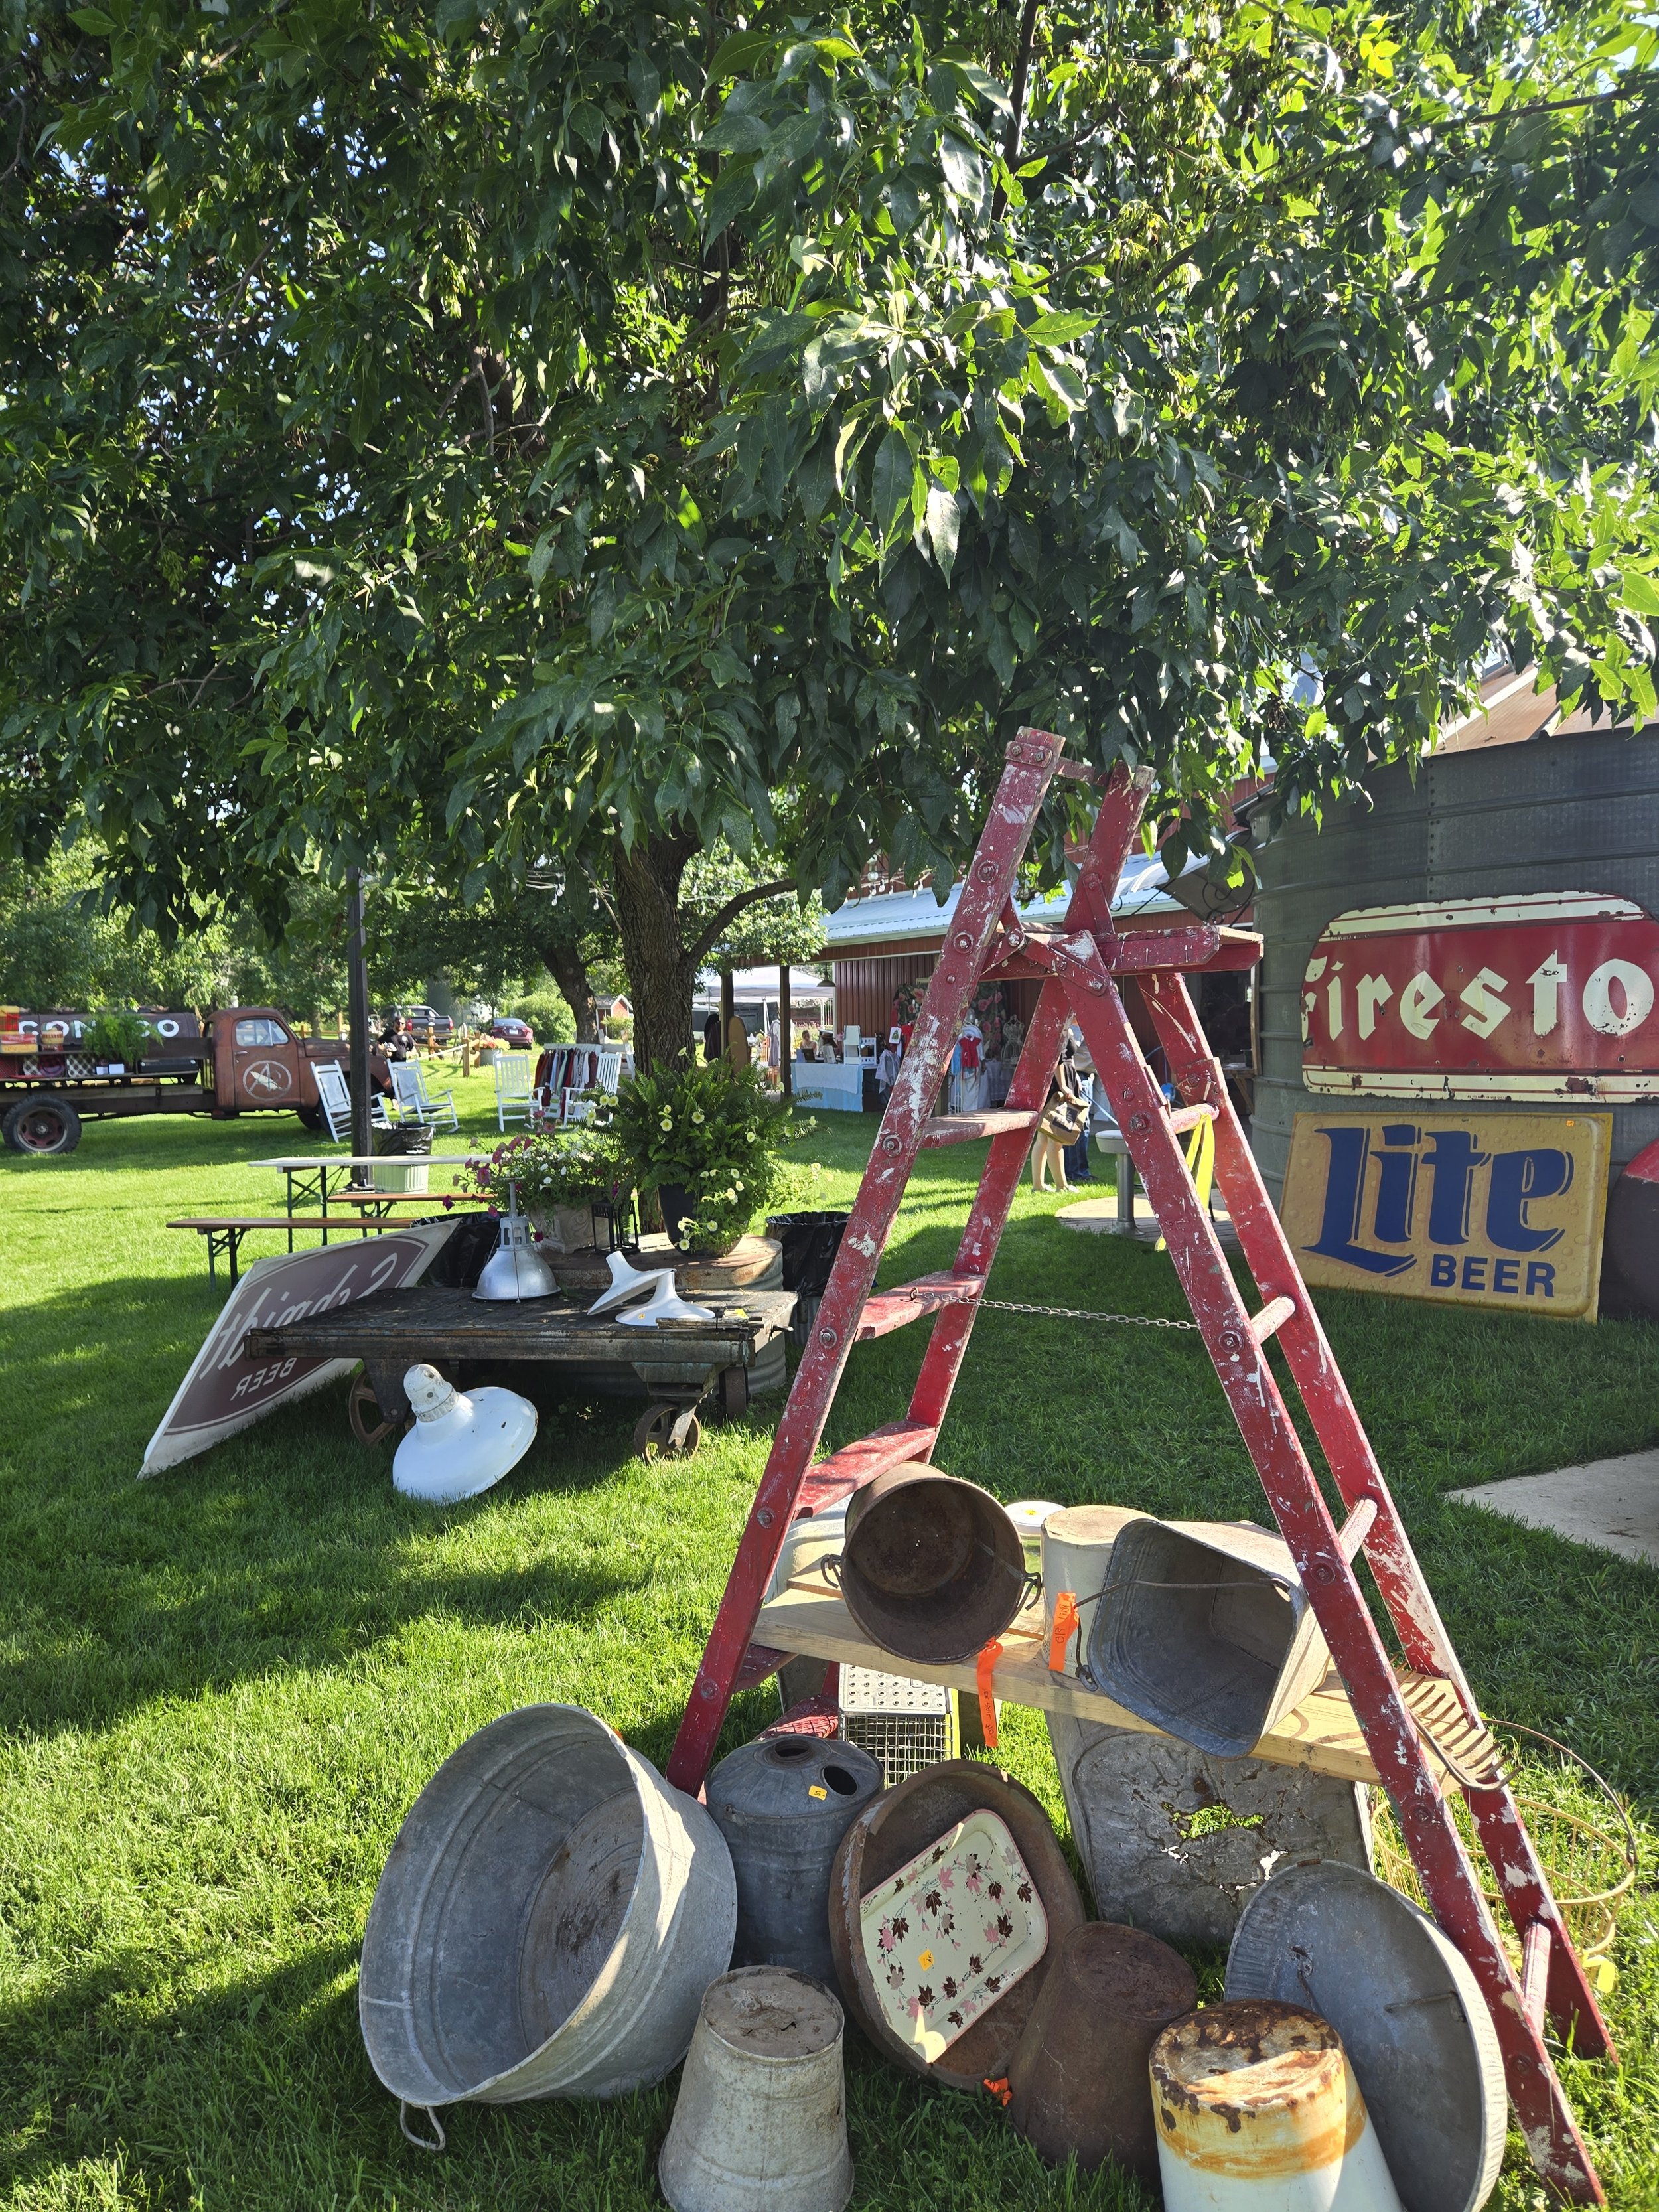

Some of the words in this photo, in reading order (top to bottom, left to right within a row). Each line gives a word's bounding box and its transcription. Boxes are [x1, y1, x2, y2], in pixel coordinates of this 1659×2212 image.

[19, 1019, 180, 1037] CONCO
[1300, 1124, 1574, 1278] Lite
[1430, 1253, 1556, 1298] BEER
